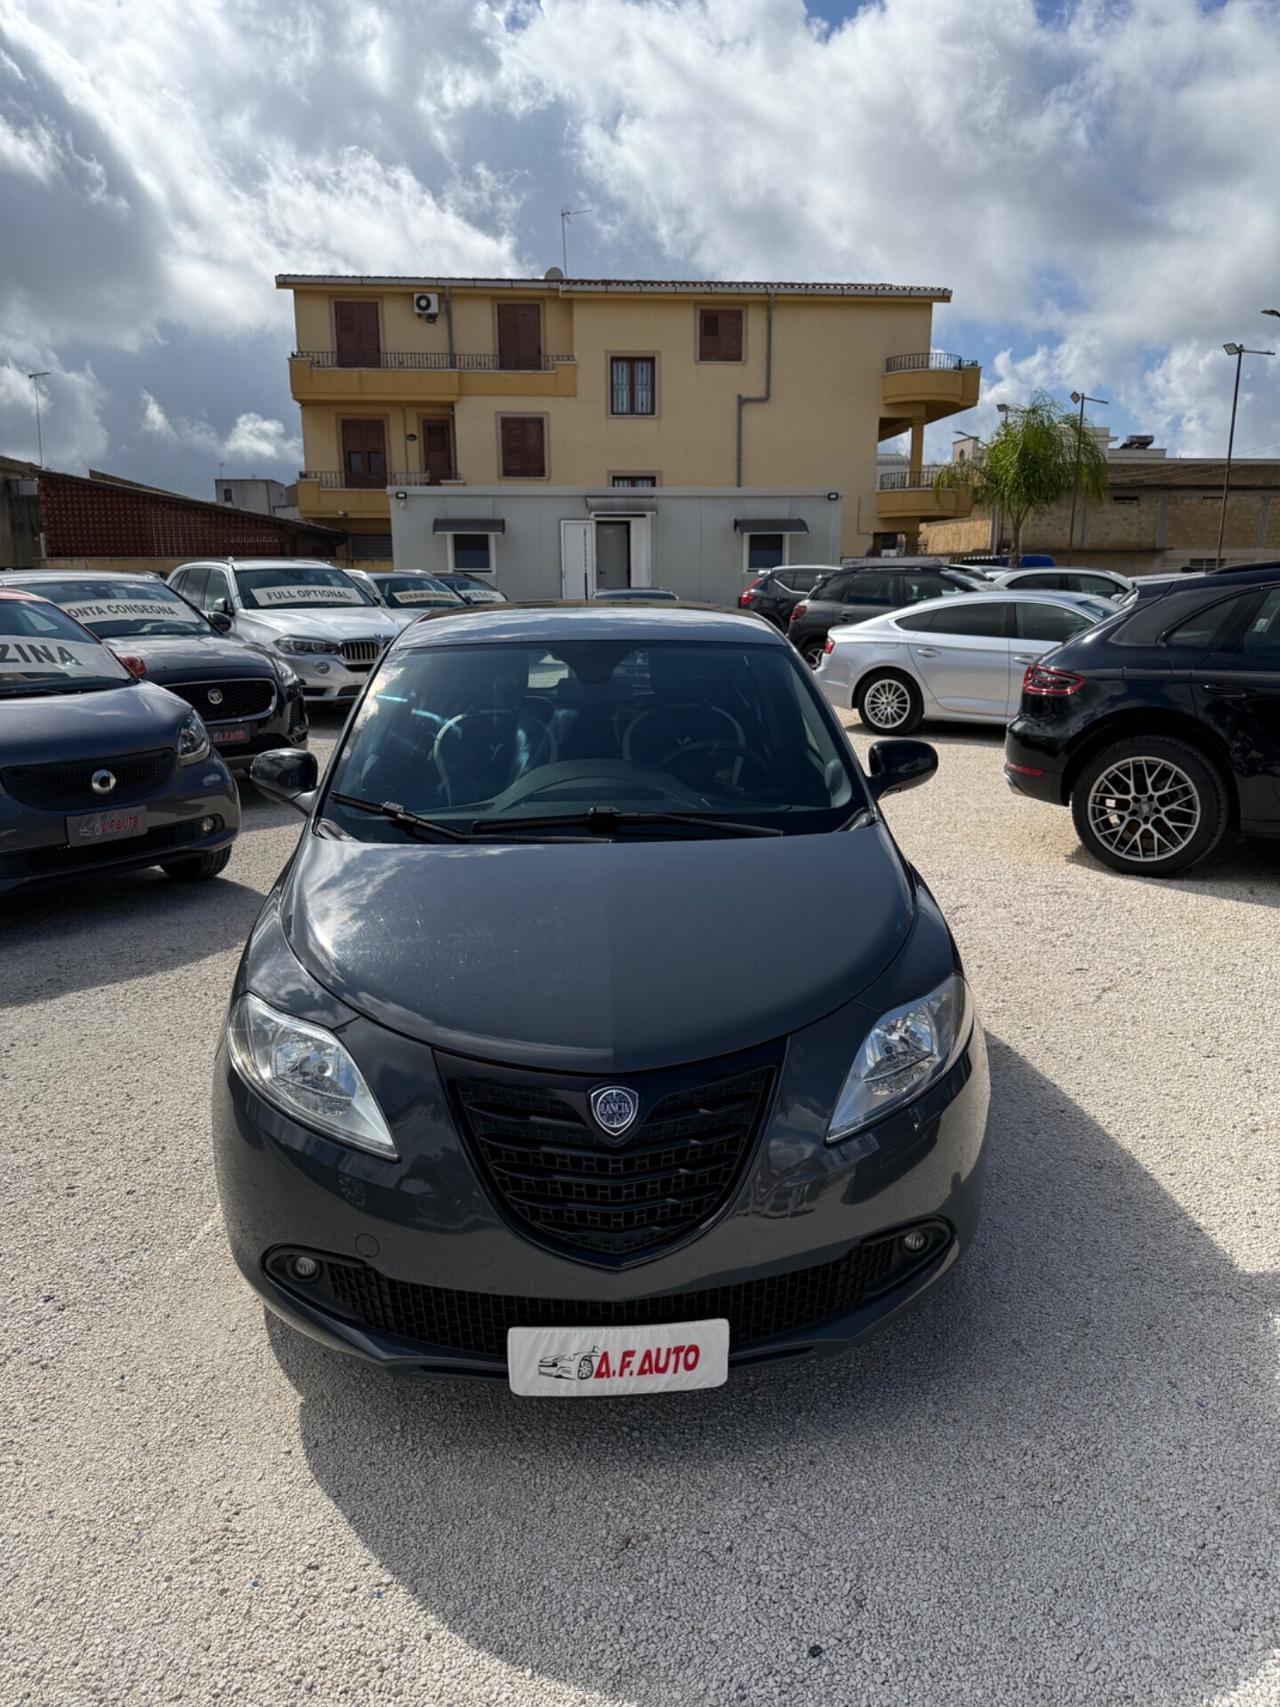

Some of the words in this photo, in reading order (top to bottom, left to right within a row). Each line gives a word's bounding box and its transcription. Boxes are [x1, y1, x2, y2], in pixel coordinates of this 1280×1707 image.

[265, 590, 296, 600] FULL
[296, 589, 352, 600] OPTIONAL
[107, 604, 179, 616] CONSEGNA
[600, 1102, 630, 1114] LANCIA
